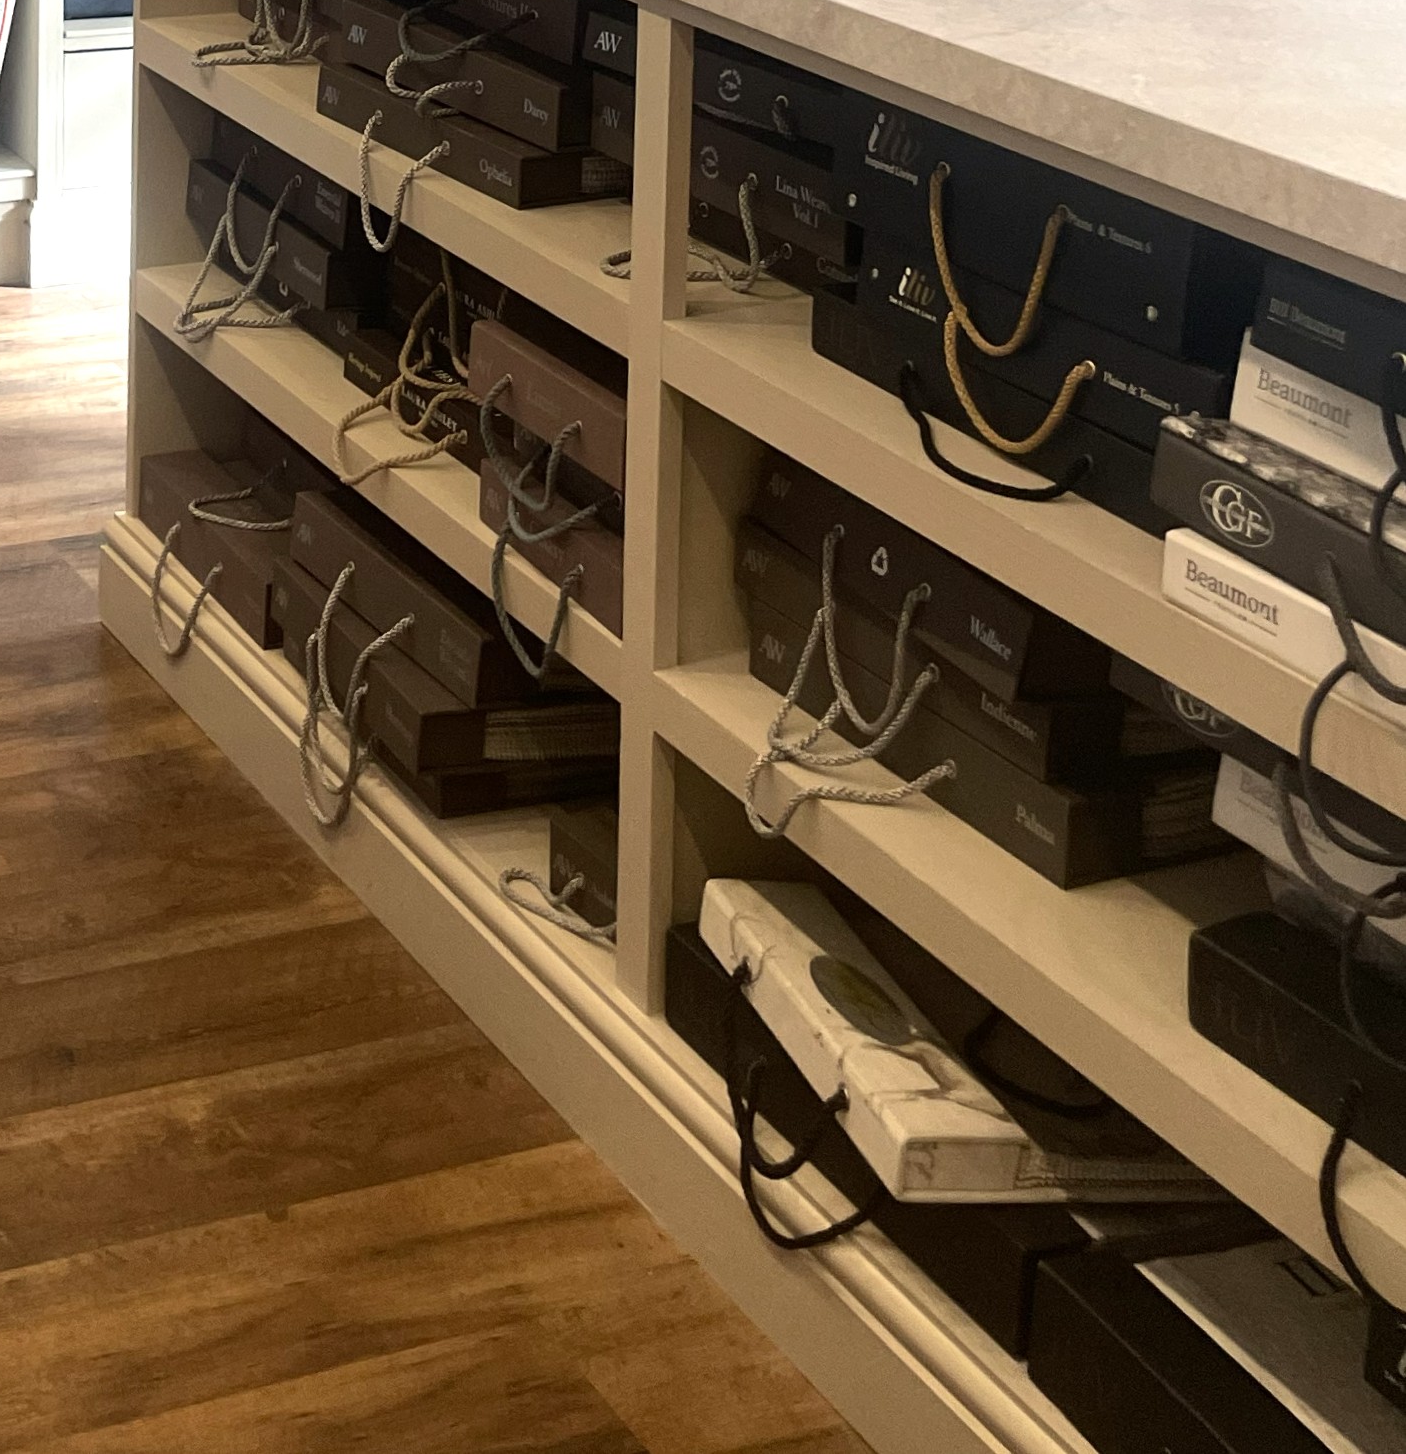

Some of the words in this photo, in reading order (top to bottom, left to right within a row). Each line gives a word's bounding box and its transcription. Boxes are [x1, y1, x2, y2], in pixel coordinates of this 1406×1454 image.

[347, 24, 369, 46] AW
[593, 30, 622, 54] AW
[523, 96, 549, 127] Darcy
[1256, 366, 1354, 430] Beaumont
[1184, 558, 1280, 626] Beaumont
[969, 613, 1013, 663] Wallace
